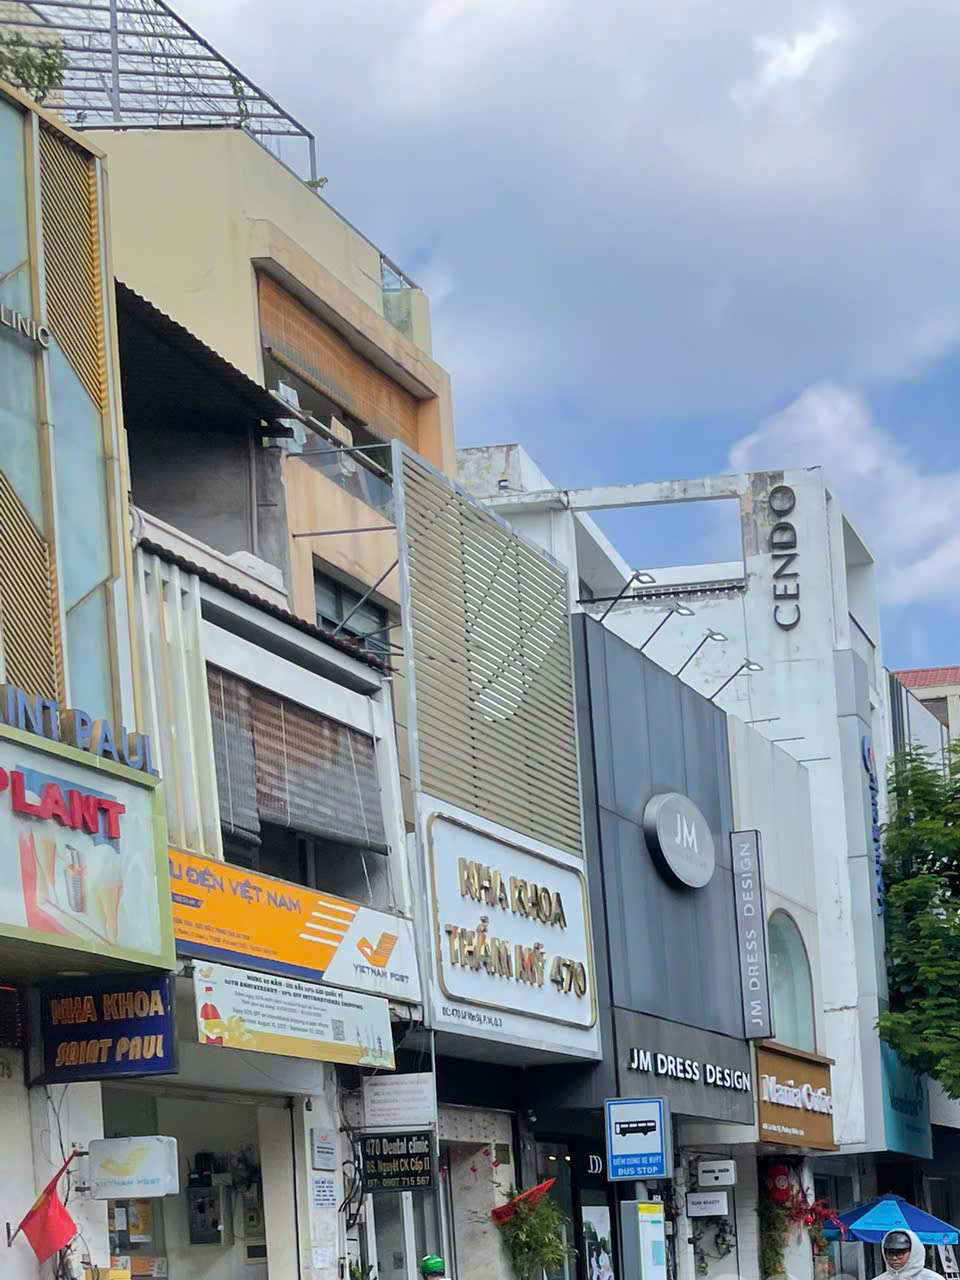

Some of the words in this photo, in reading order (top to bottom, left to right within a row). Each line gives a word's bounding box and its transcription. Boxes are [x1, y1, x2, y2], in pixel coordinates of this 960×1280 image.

[768, 484, 801, 632] CENDO
[0, 686, 59, 741] INT
[69, 709, 160, 779] PAUL
[674, 813, 698, 854] JM
[228, 878, 262, 905] VIỆT
[267, 889, 302, 914] NAM
[458, 856, 510, 912] NHA
[509, 876, 568, 931] KHOA
[739, 843, 755, 917] DESIGN
[353, 962, 388, 978] VIETNAM
[390, 972, 409, 984] POST
[445, 915, 513, 980] THẨM
[550, 955, 587, 998] 470
[746, 929, 760, 991] DRESS
[52, 996, 97, 1024] NHA
[103, 990, 165, 1020] KHOA
[751, 1000, 763, 1026] JM
[55, 1038, 113, 1067] SAINT
[115, 1034, 164, 1062] PAUL
[631, 1048, 652, 1072] JM
[657, 1053, 700, 1081] DRESS
[705, 1064, 751, 1091] DESIGN
[382, 1137, 407, 1155] Dental
[408, 1136, 430, 1153] clinic
[618, 1167, 635, 1176] BUS
[637, 1165, 658, 1175] STOP
